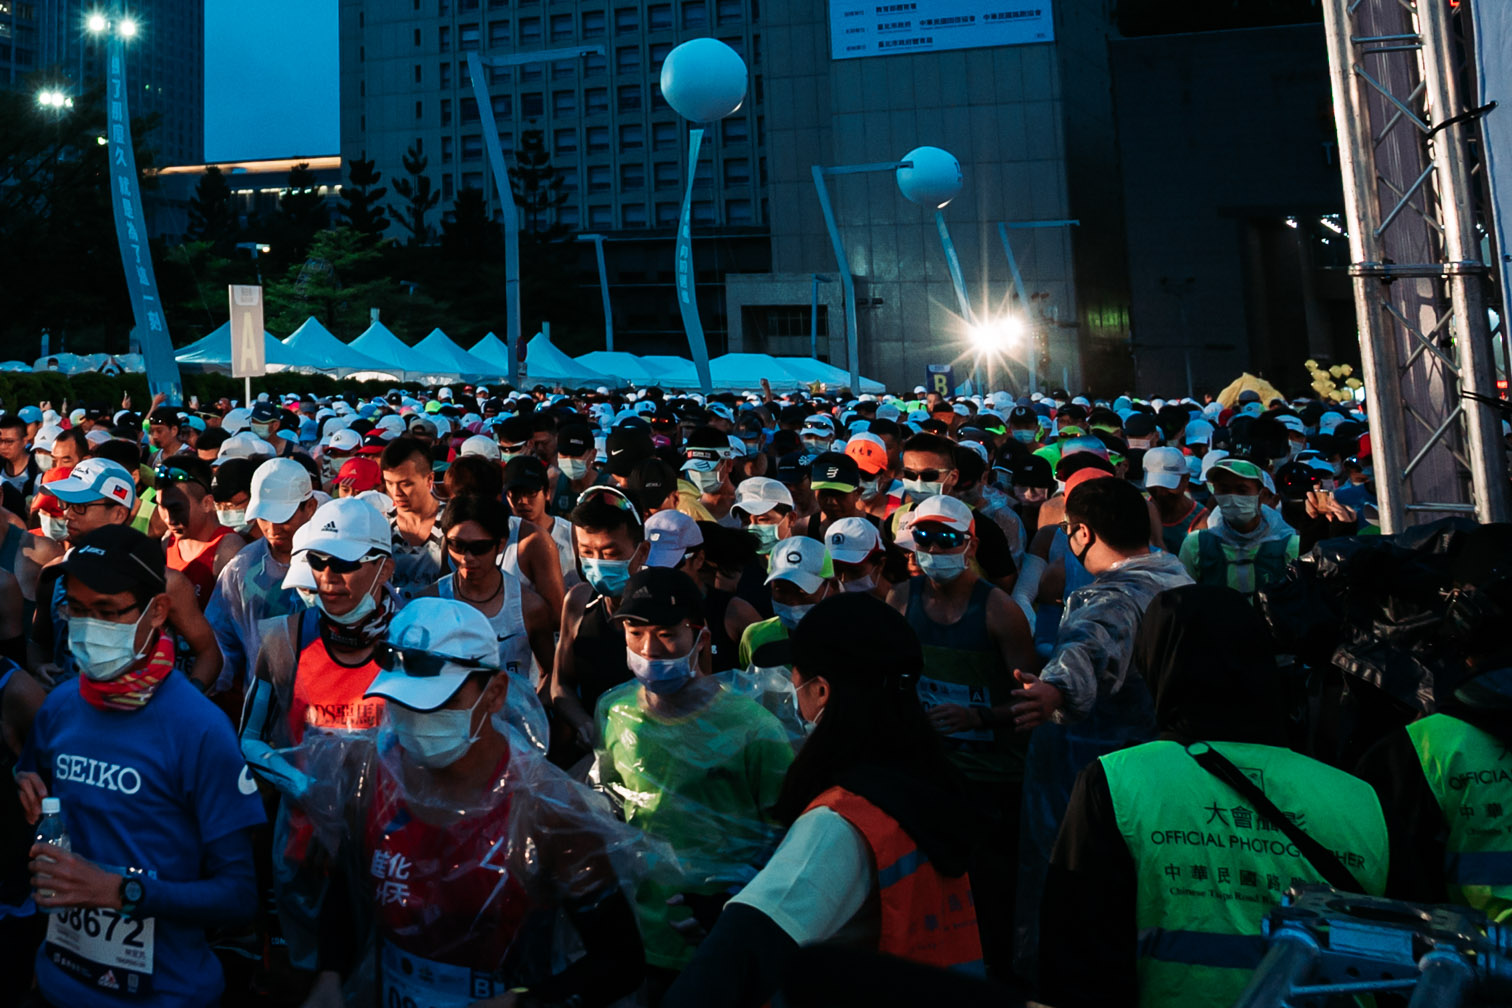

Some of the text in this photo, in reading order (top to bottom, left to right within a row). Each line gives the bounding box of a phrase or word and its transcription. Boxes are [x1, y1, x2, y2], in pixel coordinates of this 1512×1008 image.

[240, 311, 258, 372] A
[934, 374, 948, 396] B
[55, 752, 143, 795] SEIKO
[1449, 769, 1512, 791] OFFICIA
[1151, 830, 1366, 871] OFFICIAL PHOTOGHER
